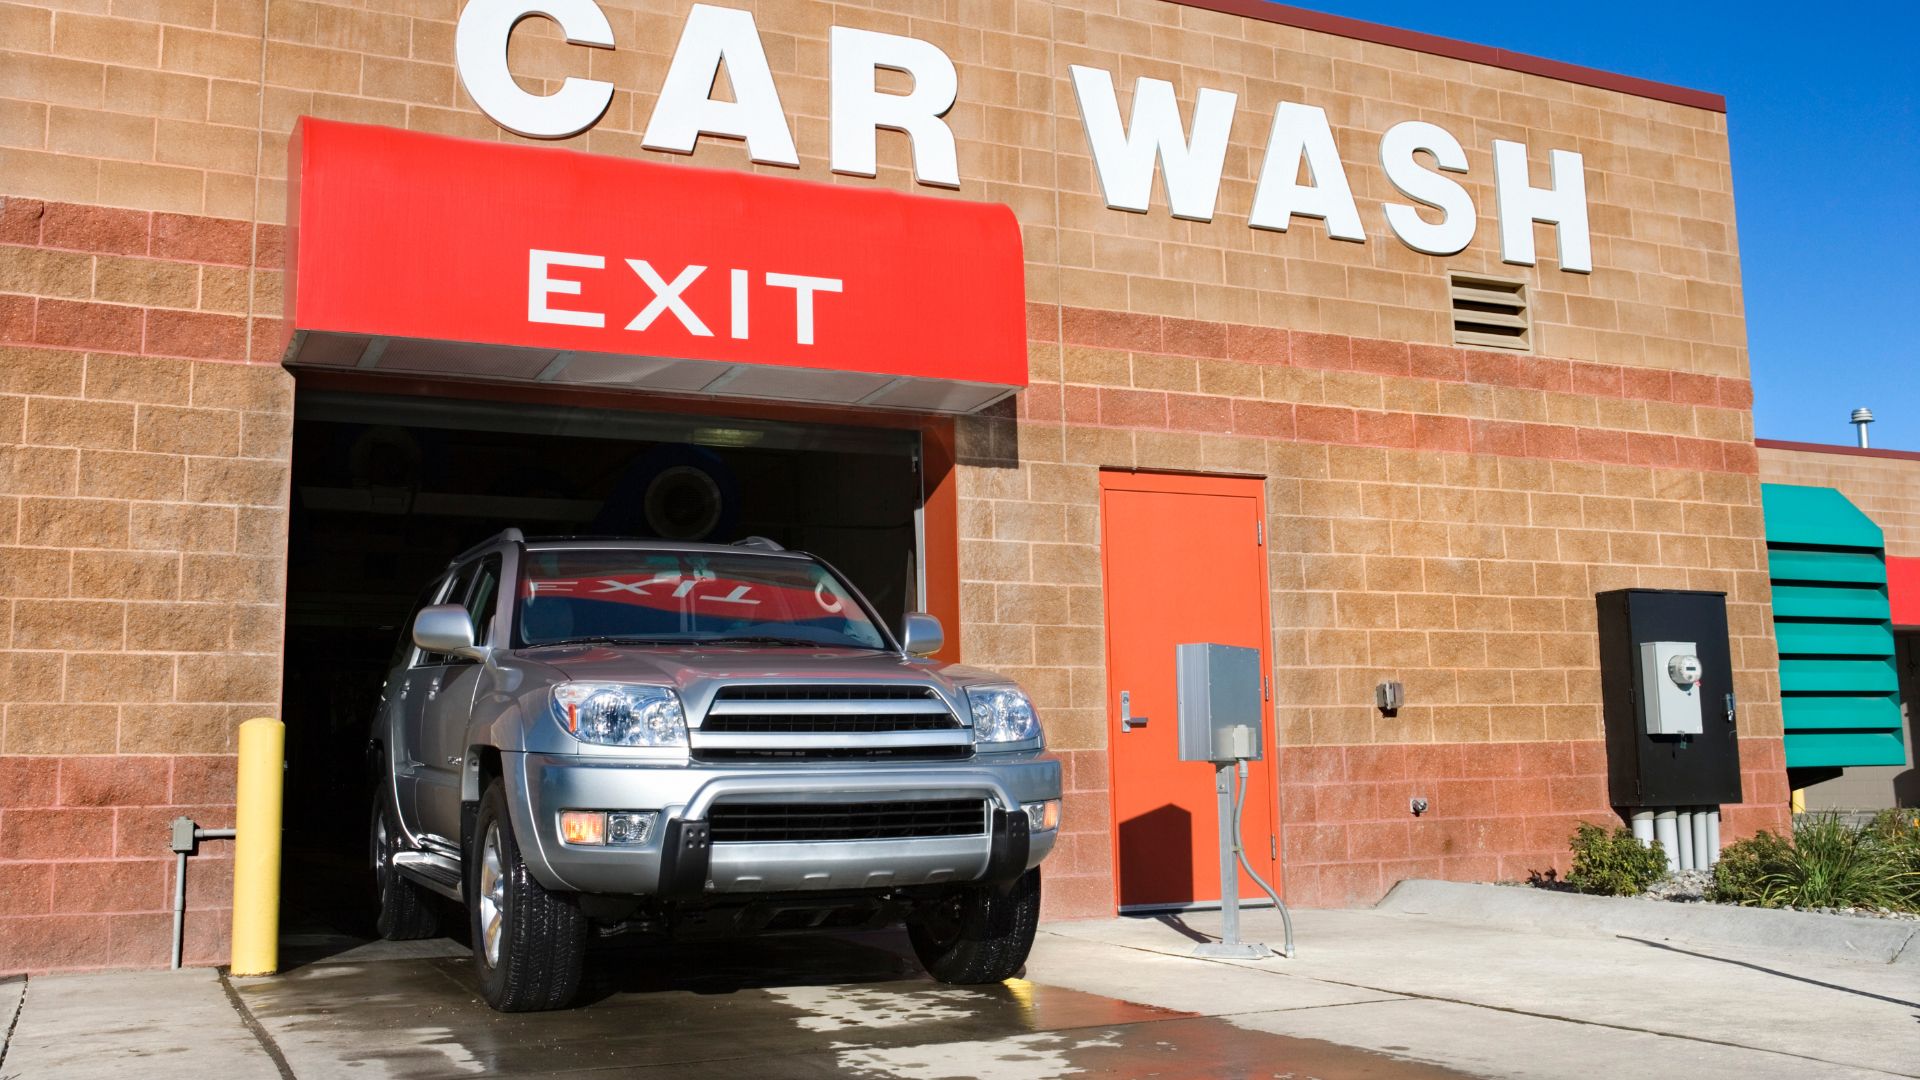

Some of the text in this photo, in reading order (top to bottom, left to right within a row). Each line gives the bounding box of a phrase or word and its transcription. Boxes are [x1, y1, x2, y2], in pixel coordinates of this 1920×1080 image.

[455, 0, 1593, 273] CAR WASH
[527, 248, 844, 345] EXIT
